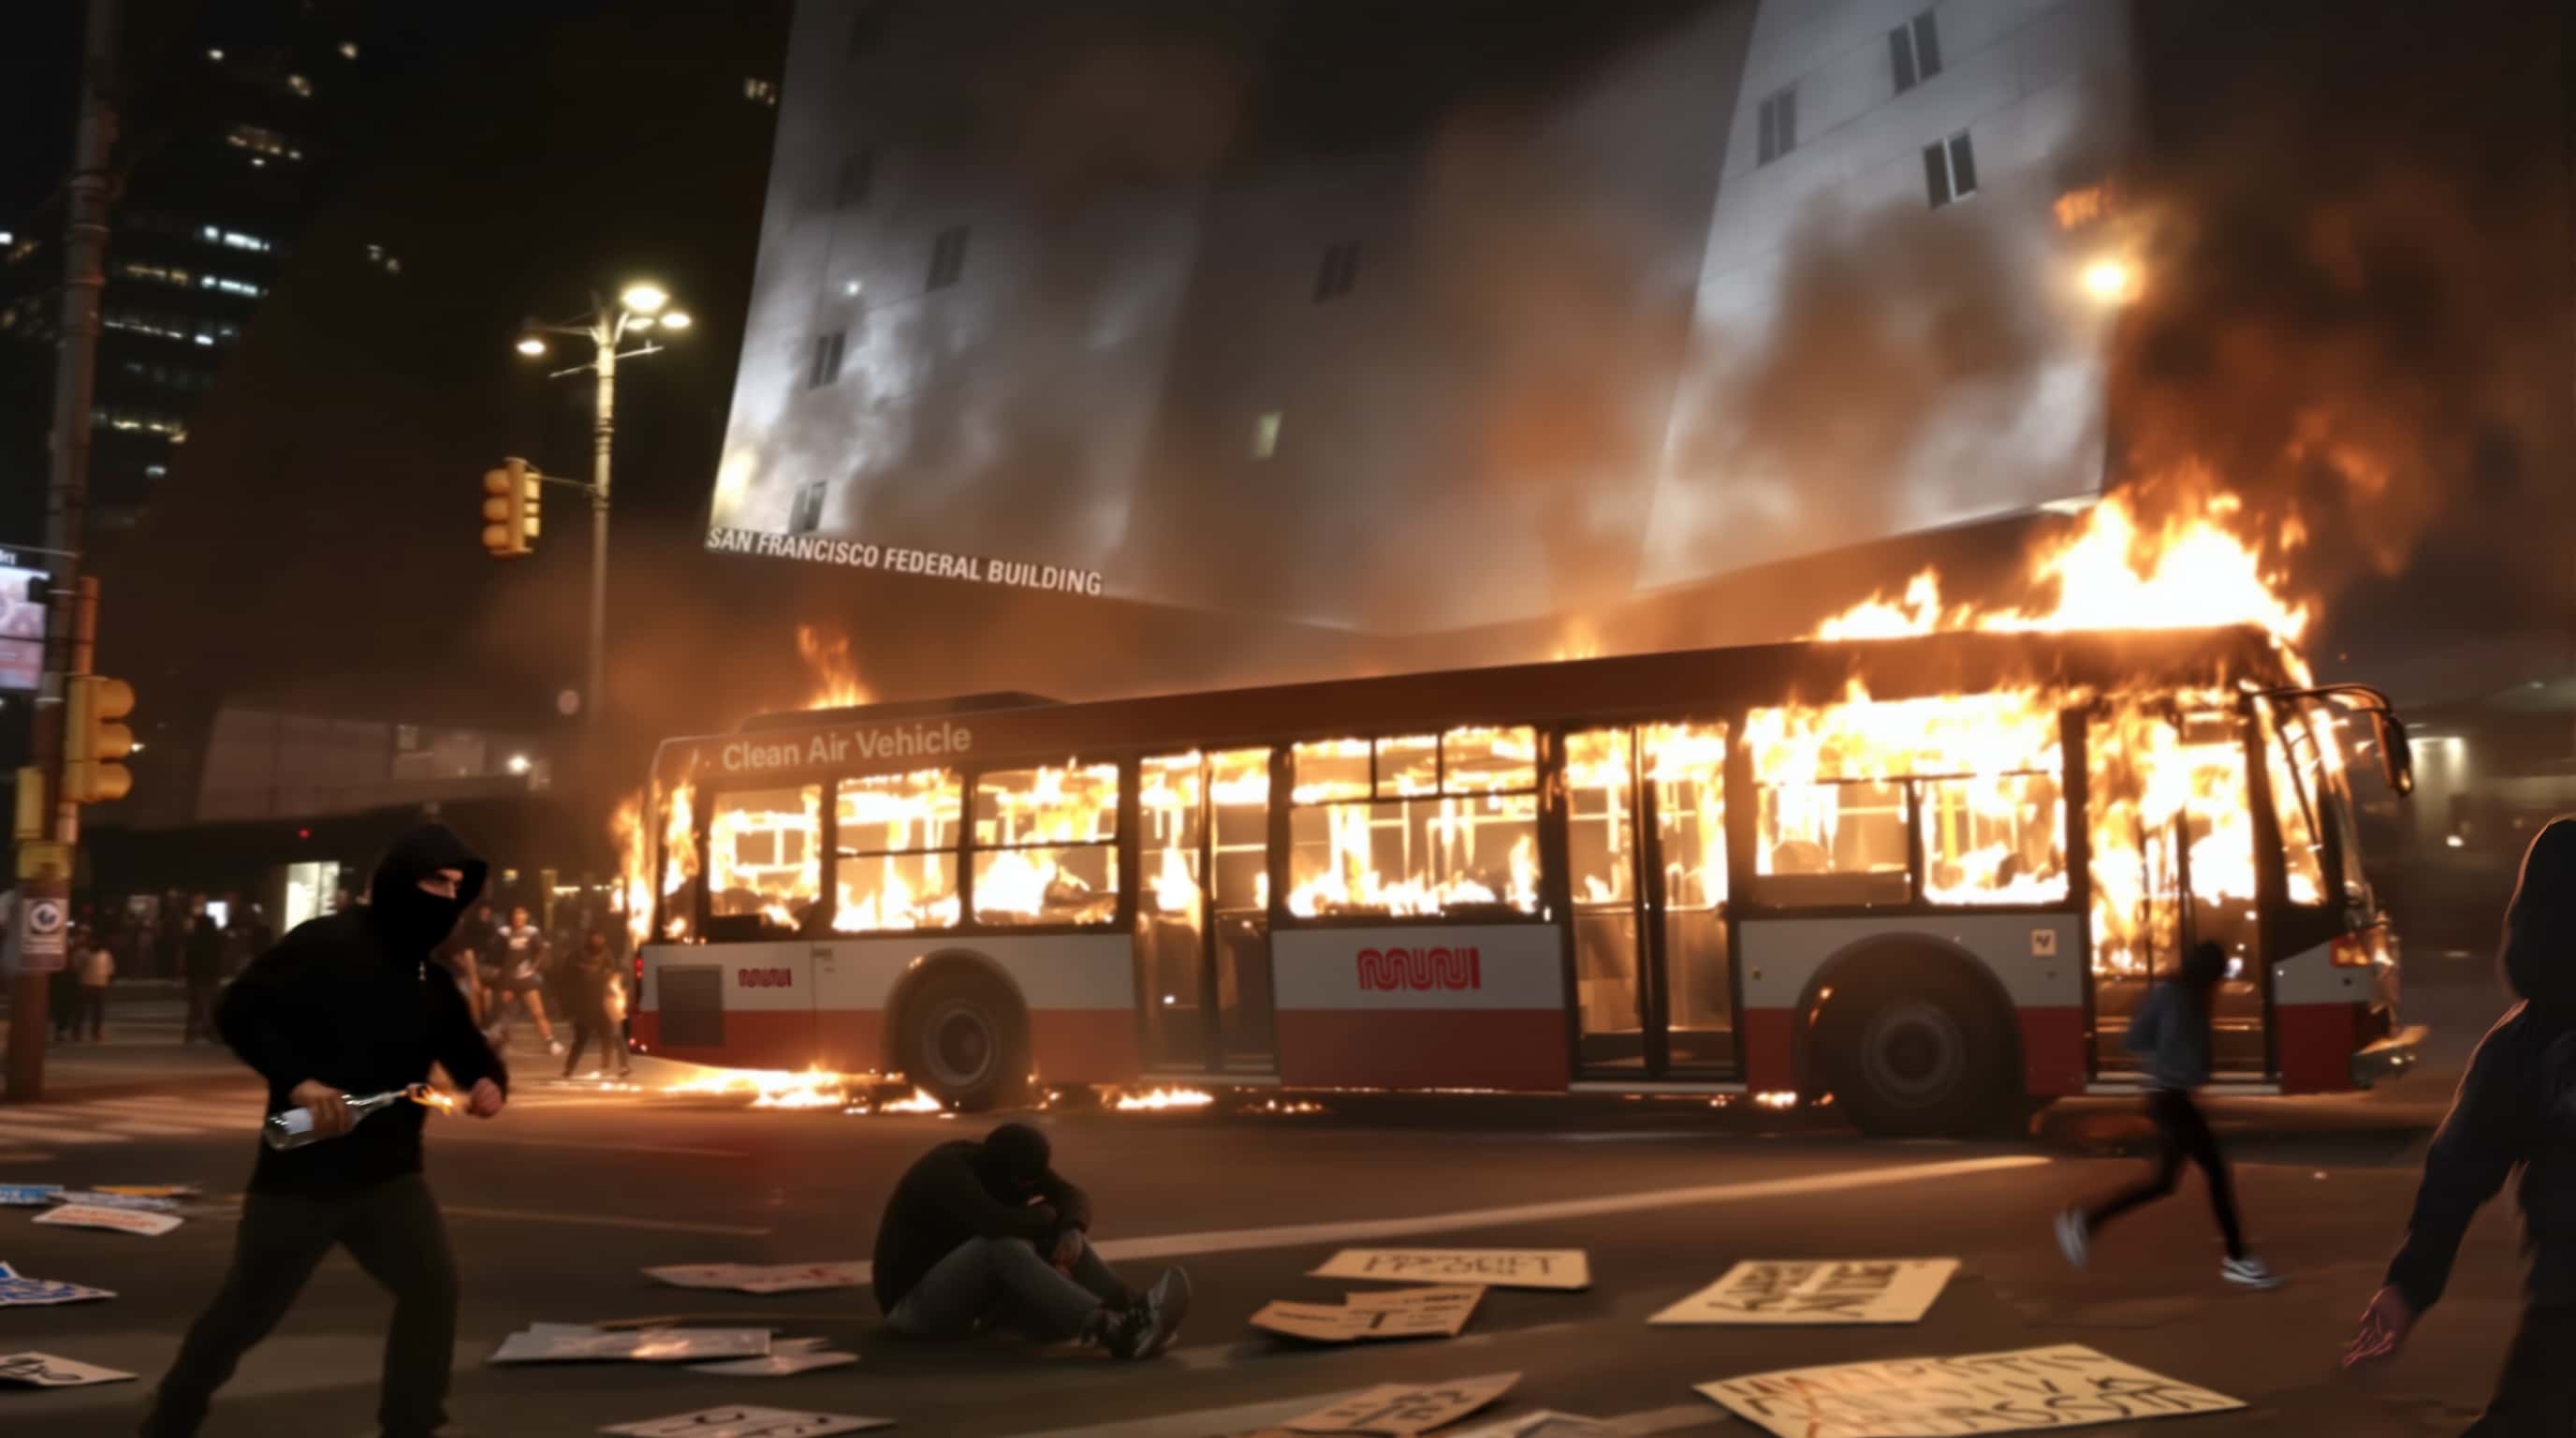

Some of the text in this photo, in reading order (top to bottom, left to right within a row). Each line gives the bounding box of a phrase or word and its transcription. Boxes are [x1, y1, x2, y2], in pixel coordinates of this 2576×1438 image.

[708, 527, 1103, 596] SAN FRANCISCO FEDERAL BUILDING
[722, 722, 973, 770] Clean Air Vehicle
